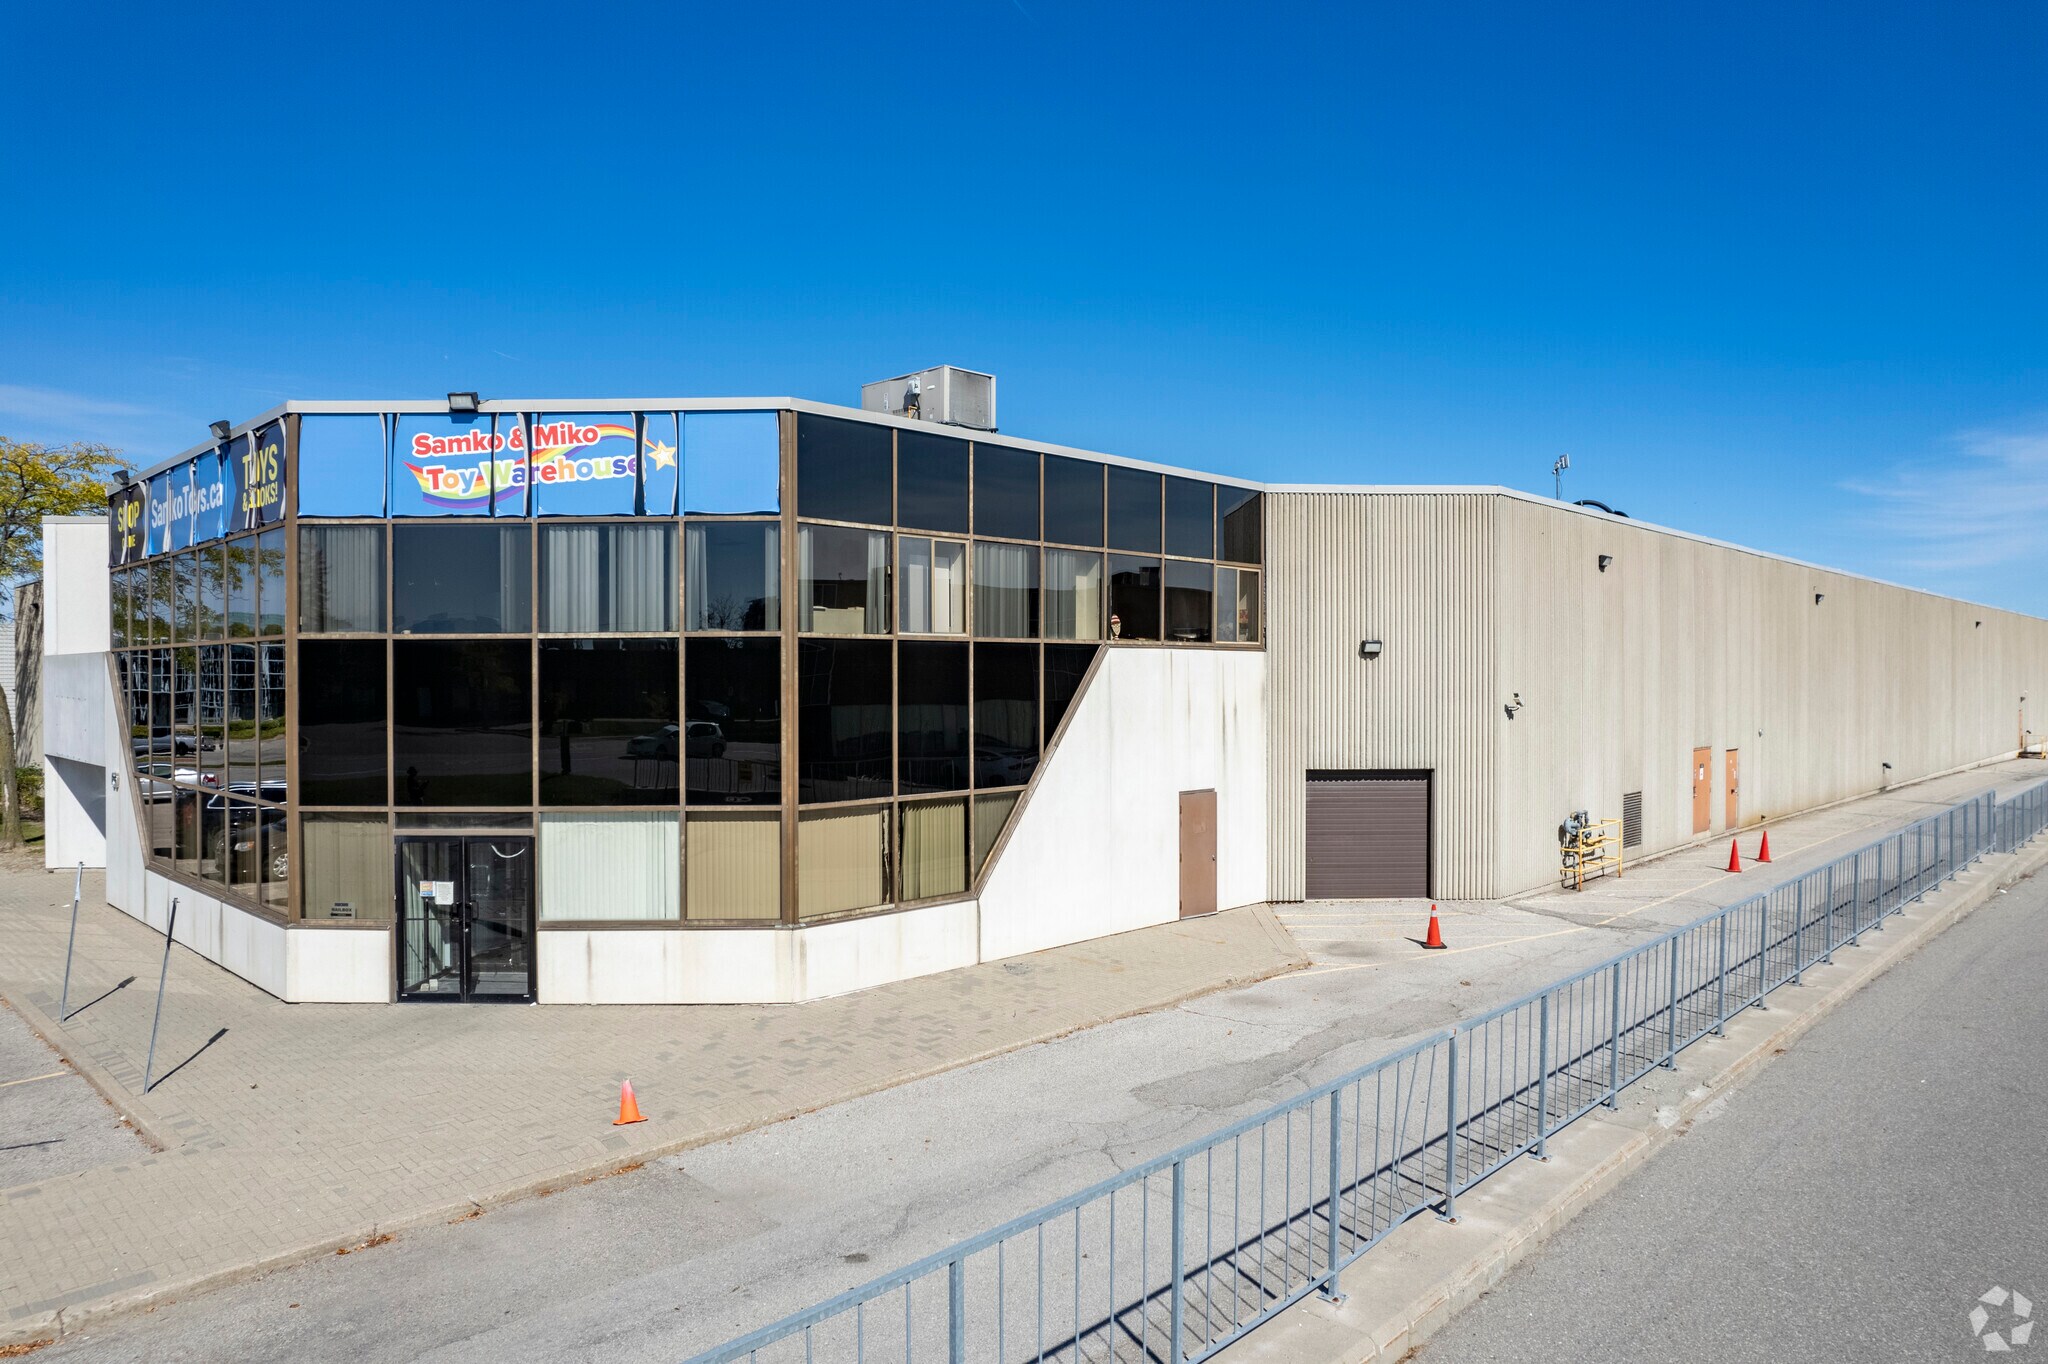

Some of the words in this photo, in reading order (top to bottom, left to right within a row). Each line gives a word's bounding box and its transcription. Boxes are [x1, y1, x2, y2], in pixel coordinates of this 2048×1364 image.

[413, 430, 504, 456] Samko
[509, 427, 524, 449] &
[533, 423, 599, 447] Miko
[426, 468, 476, 494] Toy
[481, 457, 636, 486] Warehouse
